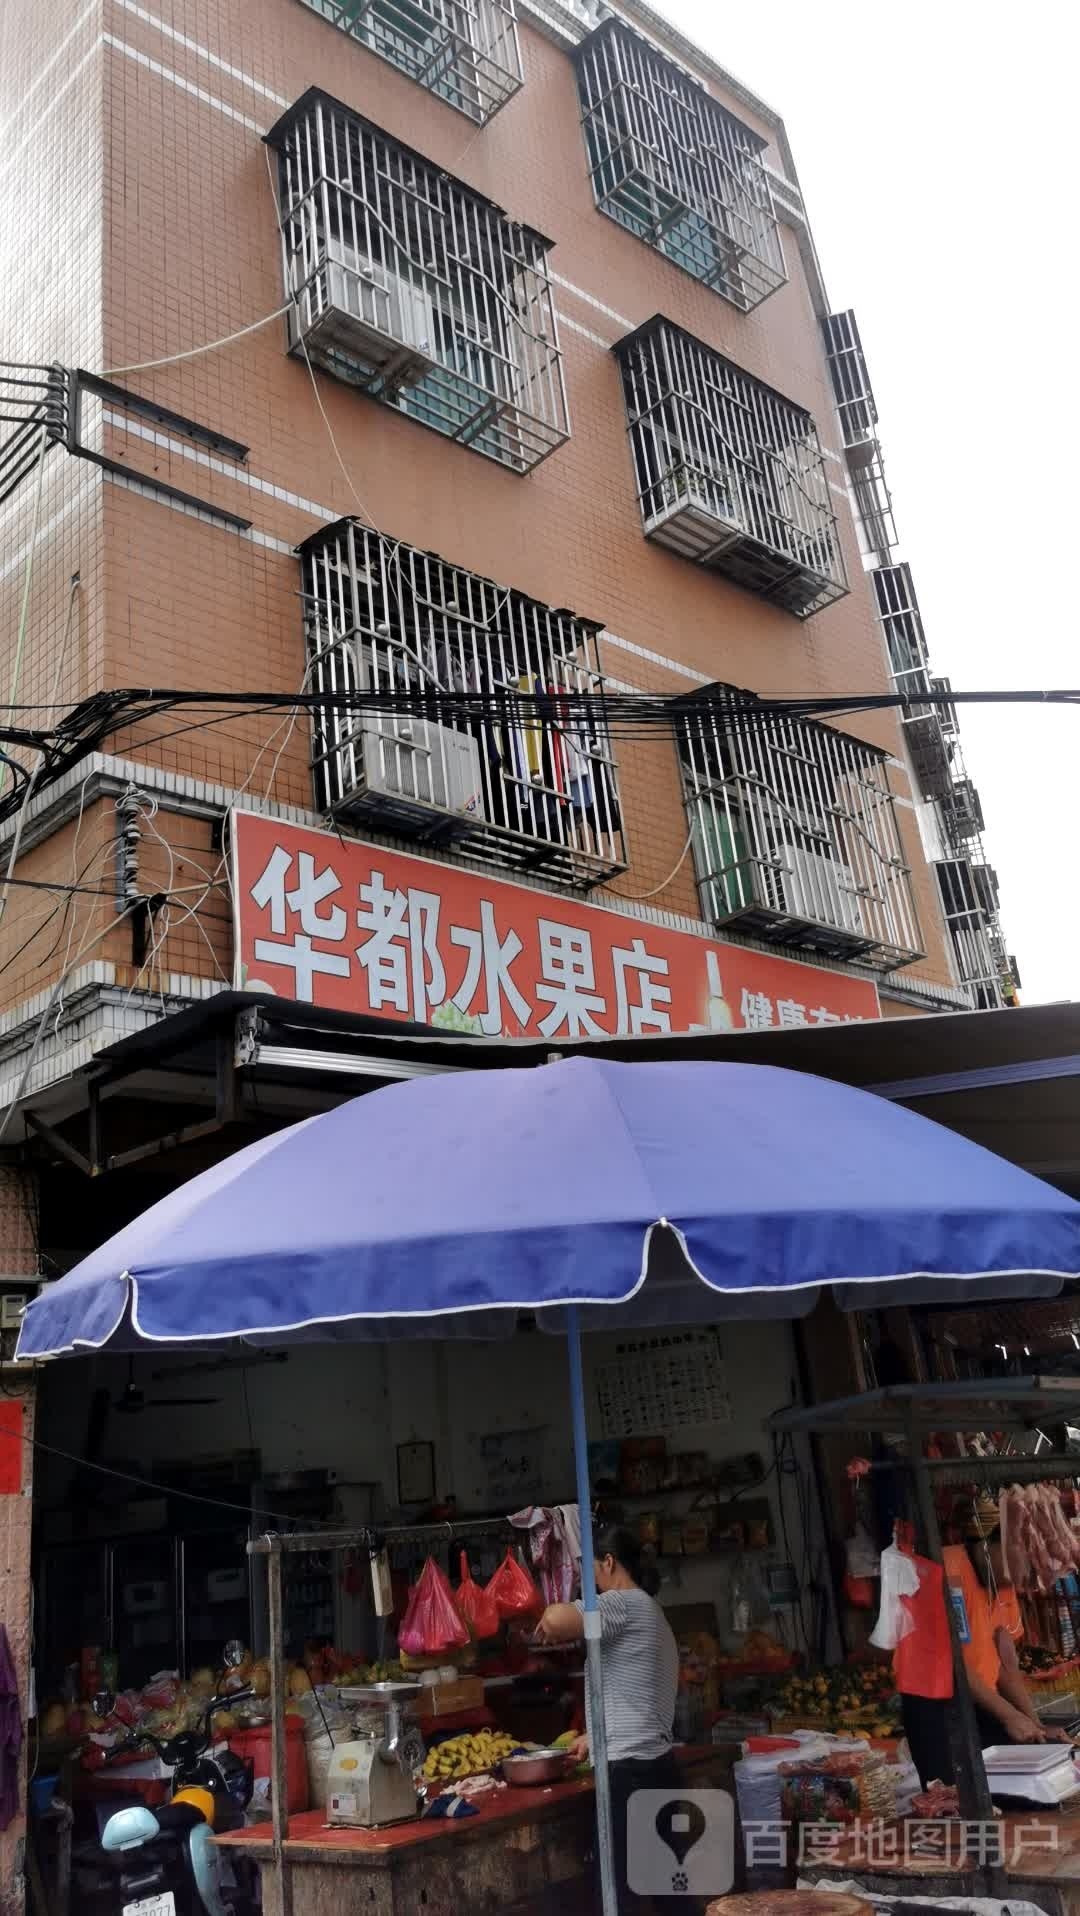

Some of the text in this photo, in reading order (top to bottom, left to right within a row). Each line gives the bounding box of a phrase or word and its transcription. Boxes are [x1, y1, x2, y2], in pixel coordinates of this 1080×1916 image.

[250, 844, 672, 1038] 华都水果店
